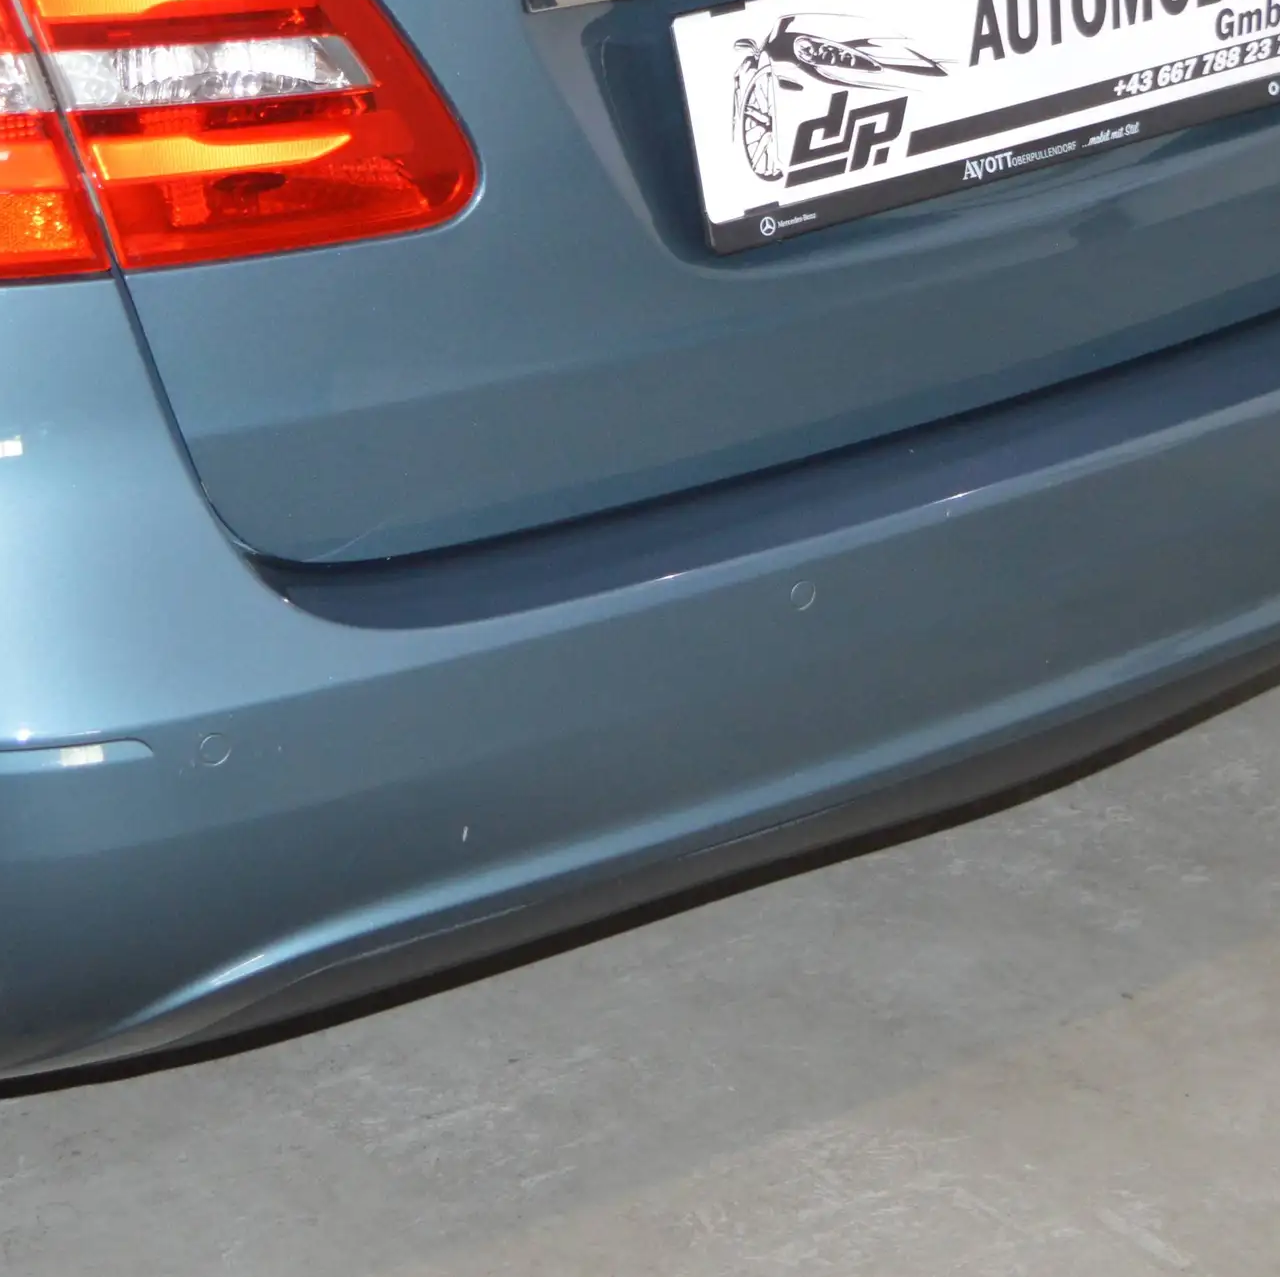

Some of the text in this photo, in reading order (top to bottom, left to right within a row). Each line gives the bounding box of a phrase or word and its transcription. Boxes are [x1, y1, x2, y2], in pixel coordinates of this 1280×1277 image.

[1113, 70, 1153, 97] +43
[1157, 57, 1197, 87] 667
[1201, 46, 1241, 74] 788
[1244, 38, 1272, 64] 23
